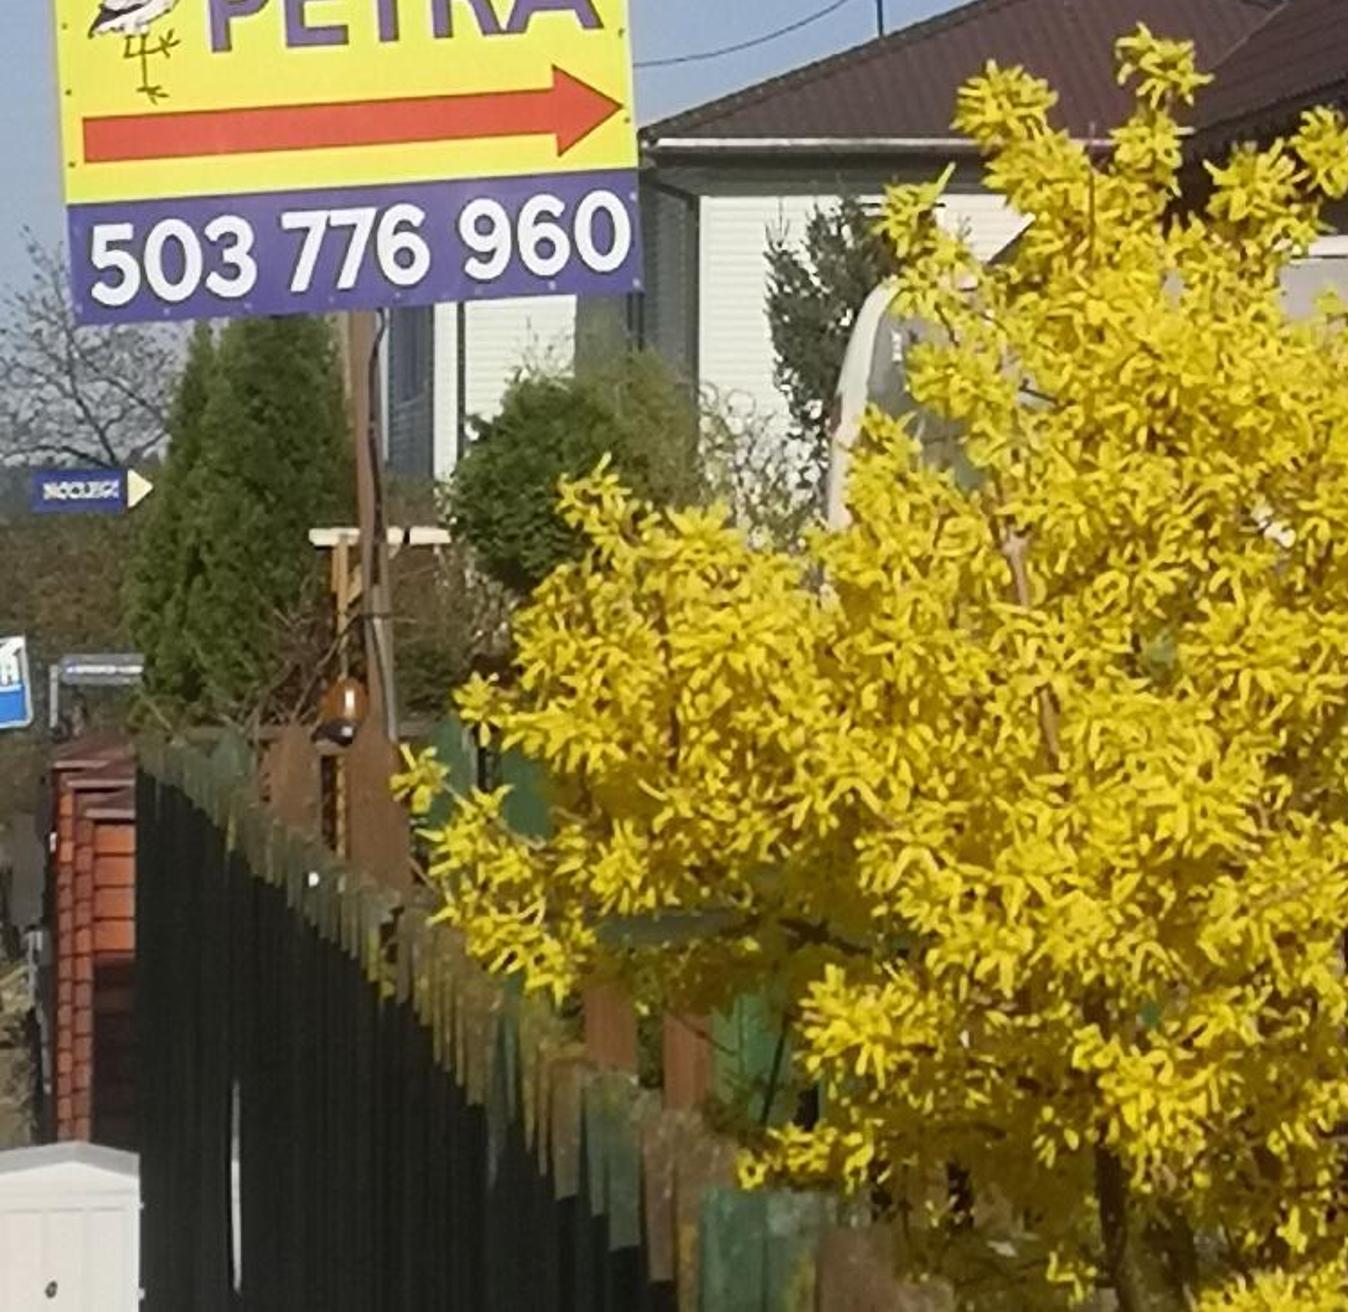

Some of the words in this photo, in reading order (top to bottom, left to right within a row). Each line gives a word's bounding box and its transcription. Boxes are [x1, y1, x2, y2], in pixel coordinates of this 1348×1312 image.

[90, 214, 257, 306] 503
[281, 203, 430, 293] 776
[458, 189, 632, 281] 960
